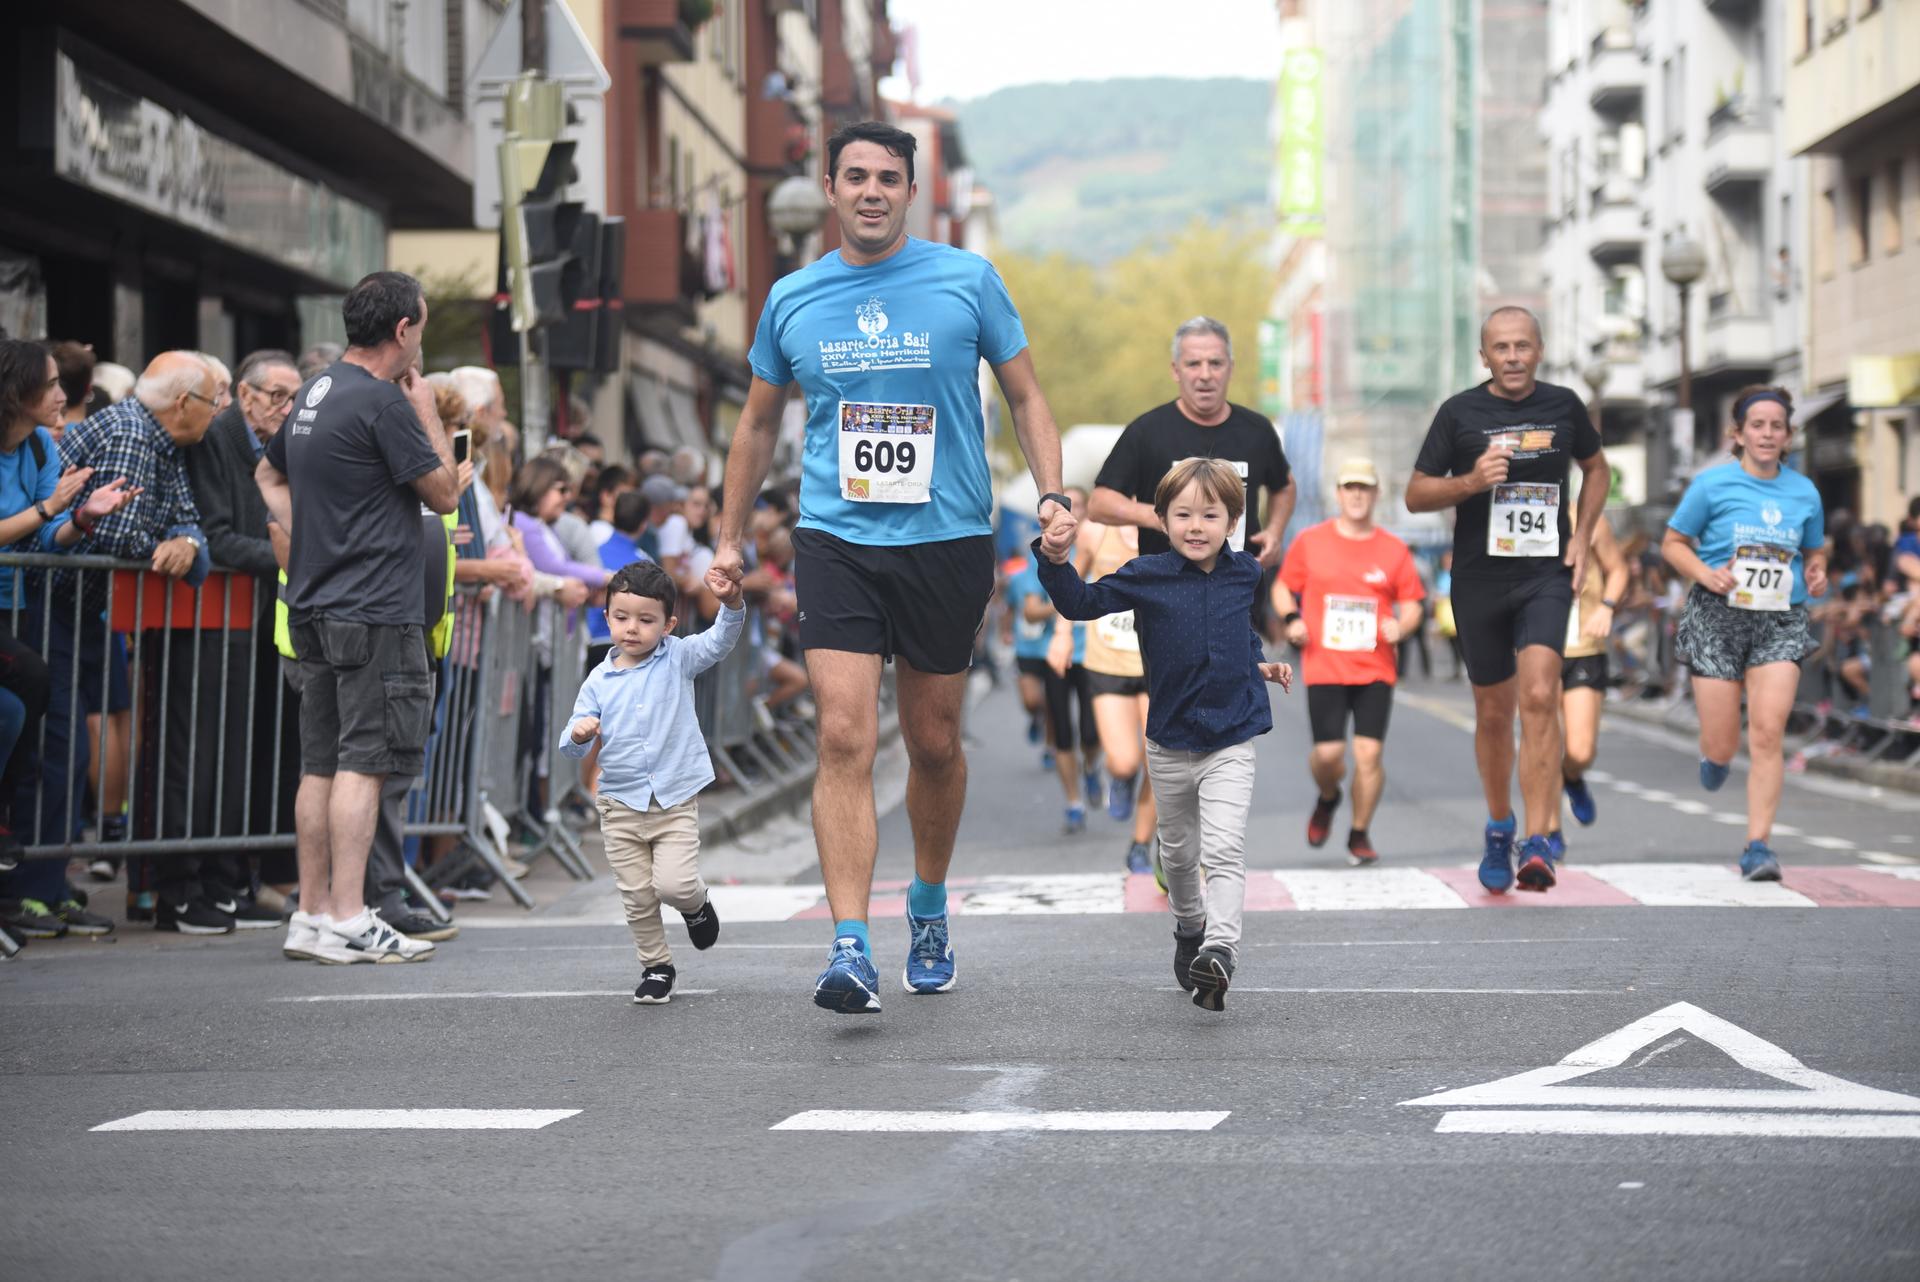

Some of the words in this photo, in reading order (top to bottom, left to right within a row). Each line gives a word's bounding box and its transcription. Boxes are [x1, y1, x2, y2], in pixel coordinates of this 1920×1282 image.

[903, 332, 930, 349] Bai!
[821, 353, 850, 362] XXIV.
[852, 351, 878, 359] Kros
[855, 440, 916, 474] 609
[1506, 510, 1547, 533] 194
[1745, 567, 1784, 589] 707
[1336, 617, 1365, 635] 311
